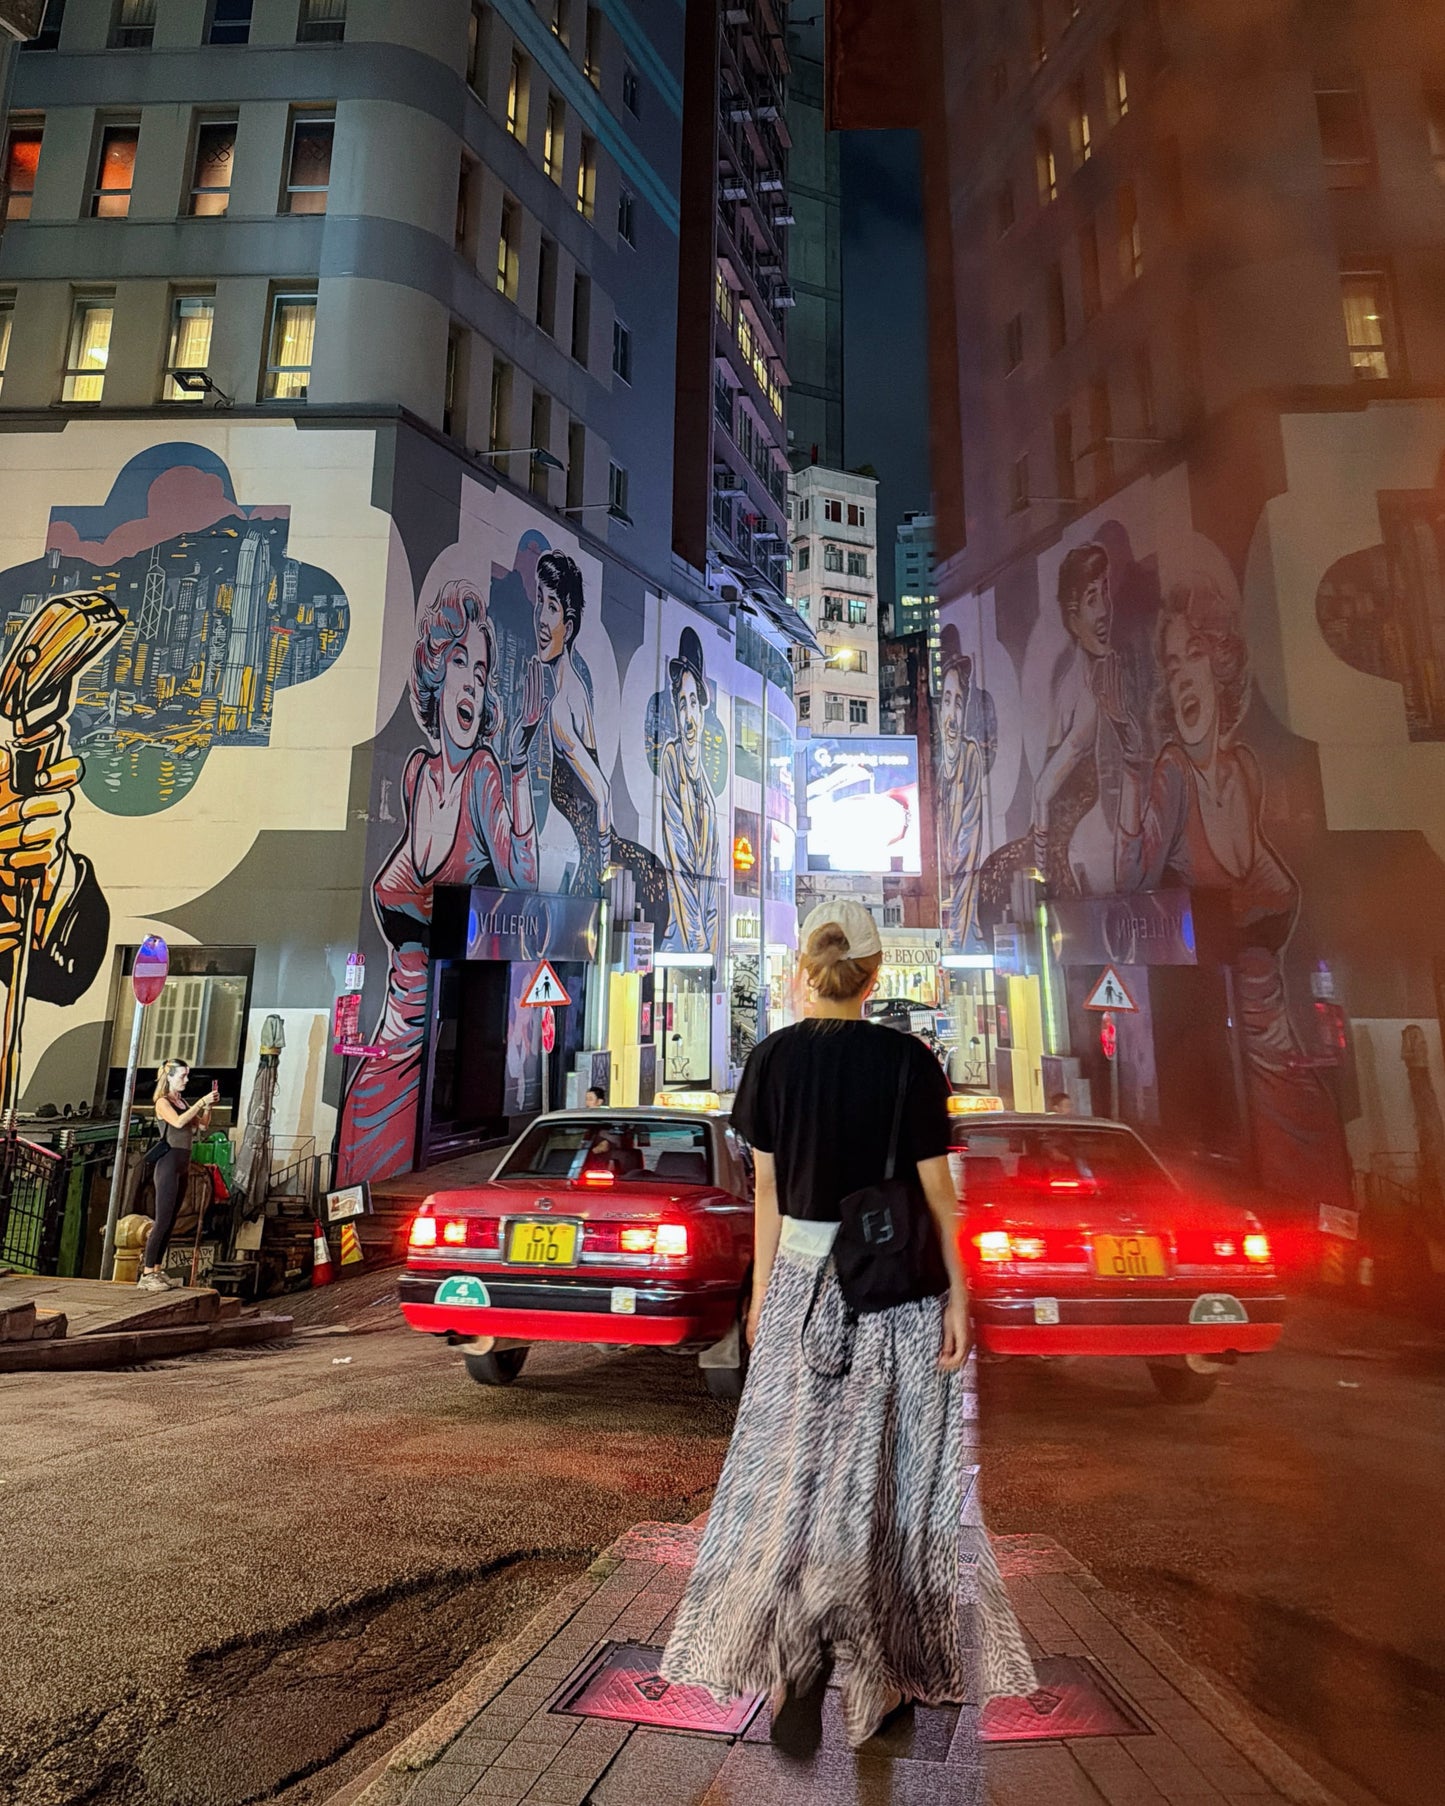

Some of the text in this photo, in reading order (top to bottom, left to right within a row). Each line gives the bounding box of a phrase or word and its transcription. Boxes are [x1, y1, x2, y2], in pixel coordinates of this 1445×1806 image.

[884, 948, 938, 964] & BEYOND
[532, 1225, 558, 1243] CY
[525, 1243, 559, 1261] 1110
[455, 1283, 470, 1296] 4
